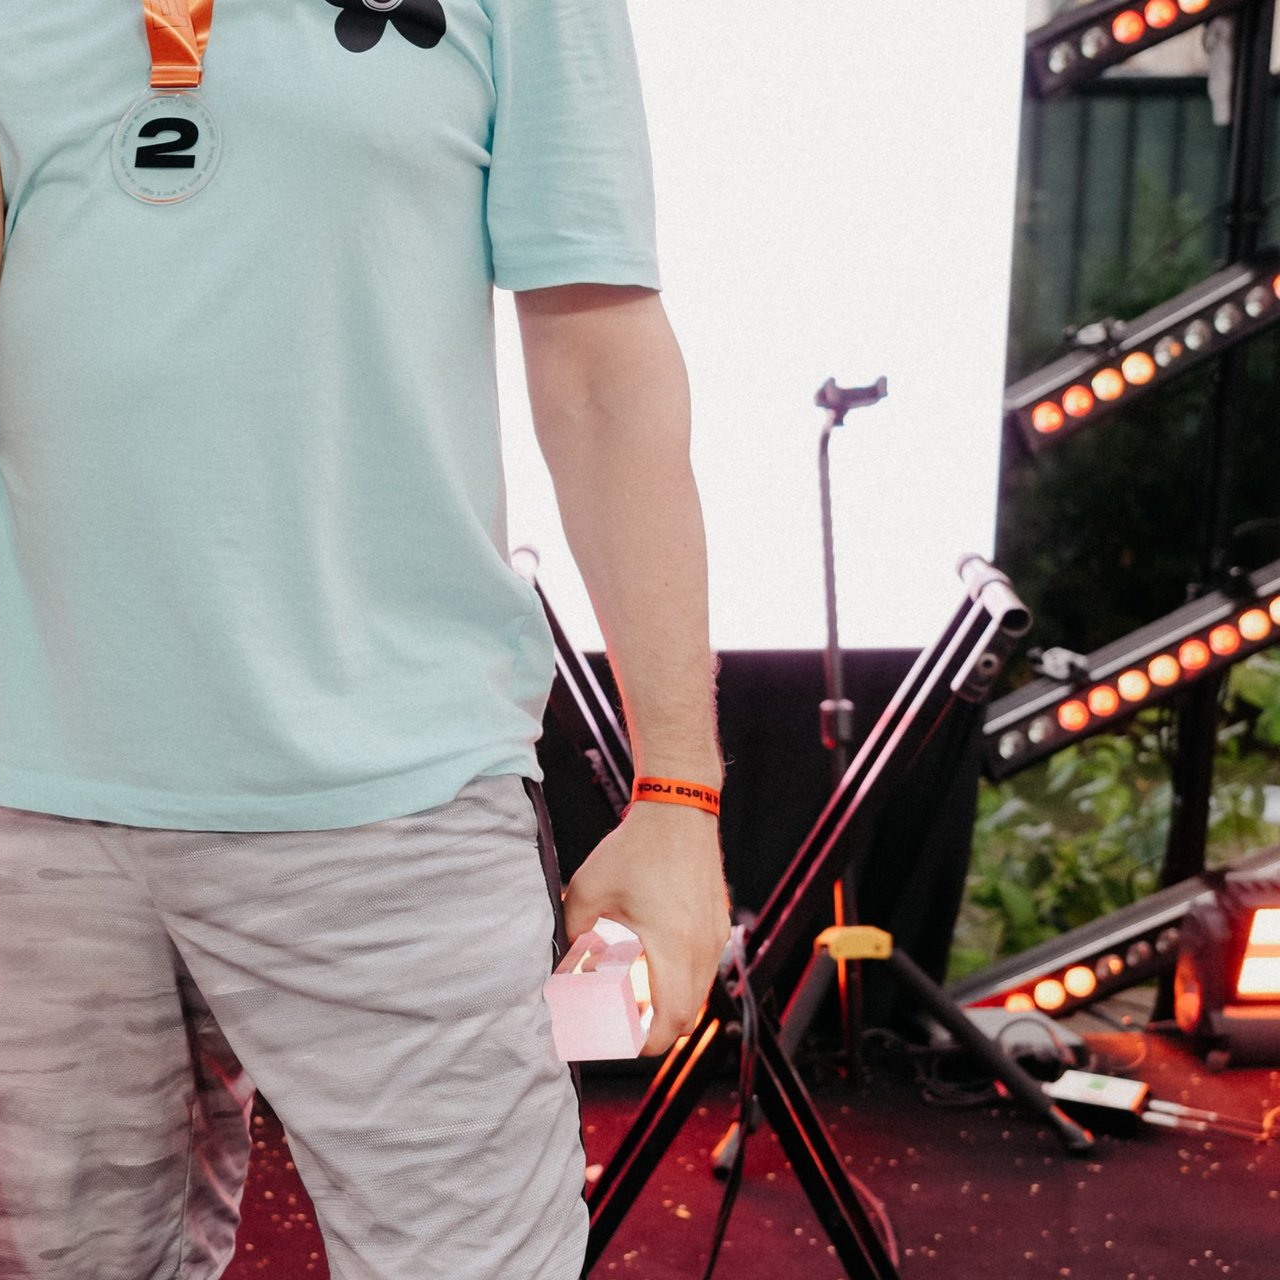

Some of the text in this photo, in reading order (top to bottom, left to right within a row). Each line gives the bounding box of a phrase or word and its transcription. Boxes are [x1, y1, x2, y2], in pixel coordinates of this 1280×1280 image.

[135, 117, 199, 169] 2
[637, 783, 671, 794] rock
[676, 786, 703, 801] lets
